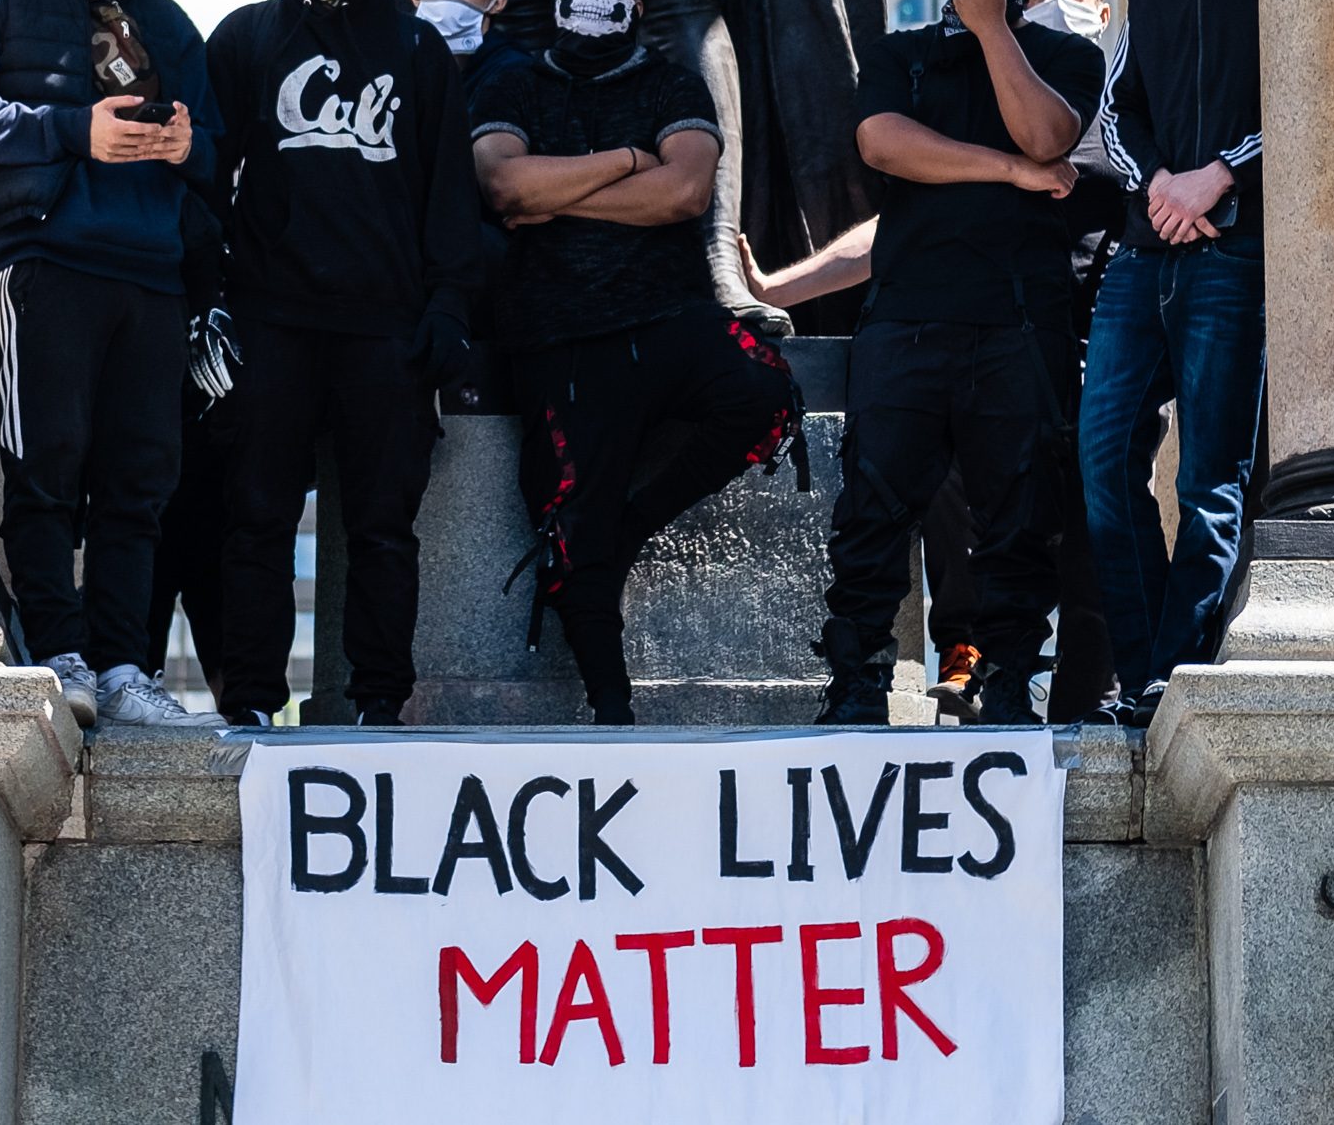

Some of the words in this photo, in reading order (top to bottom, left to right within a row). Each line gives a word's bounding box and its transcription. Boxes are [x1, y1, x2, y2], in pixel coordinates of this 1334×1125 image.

[276, 54, 402, 161] Cali
[287, 766, 645, 901] BLACK
[719, 751, 1028, 881] LIVES
[439, 918, 956, 1067] MATTER
